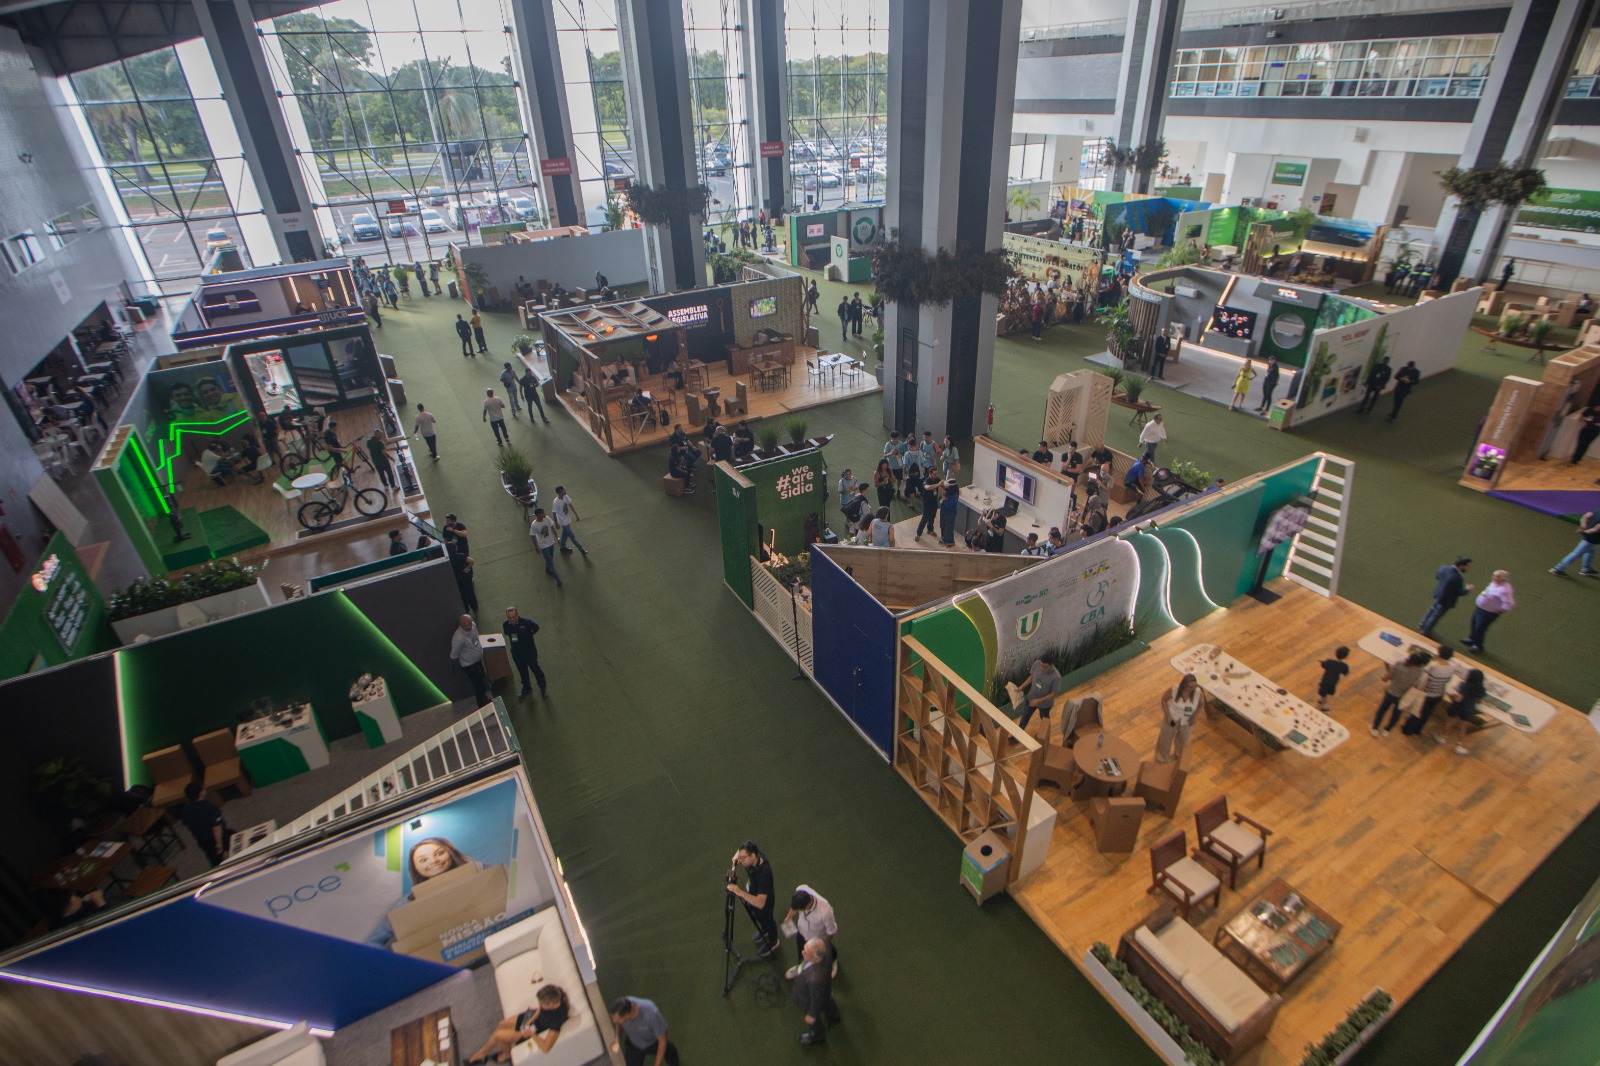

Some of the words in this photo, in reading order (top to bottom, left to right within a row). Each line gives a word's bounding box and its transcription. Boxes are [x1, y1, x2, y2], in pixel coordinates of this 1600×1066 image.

[1141, 291, 1163, 303] SEMP
[1278, 288, 1298, 299] TCL
[668, 305, 708, 318] ASSEMBLEIA
[669, 312, 709, 323] EGISLATIVA
[791, 465, 809, 476] we
[781, 482, 814, 500] sidia
[1080, 605, 1105, 625] CBA
[264, 875, 343, 919] pce
[438, 918, 479, 941] NOSSA
[441, 912, 507, 948] MISSÃO
